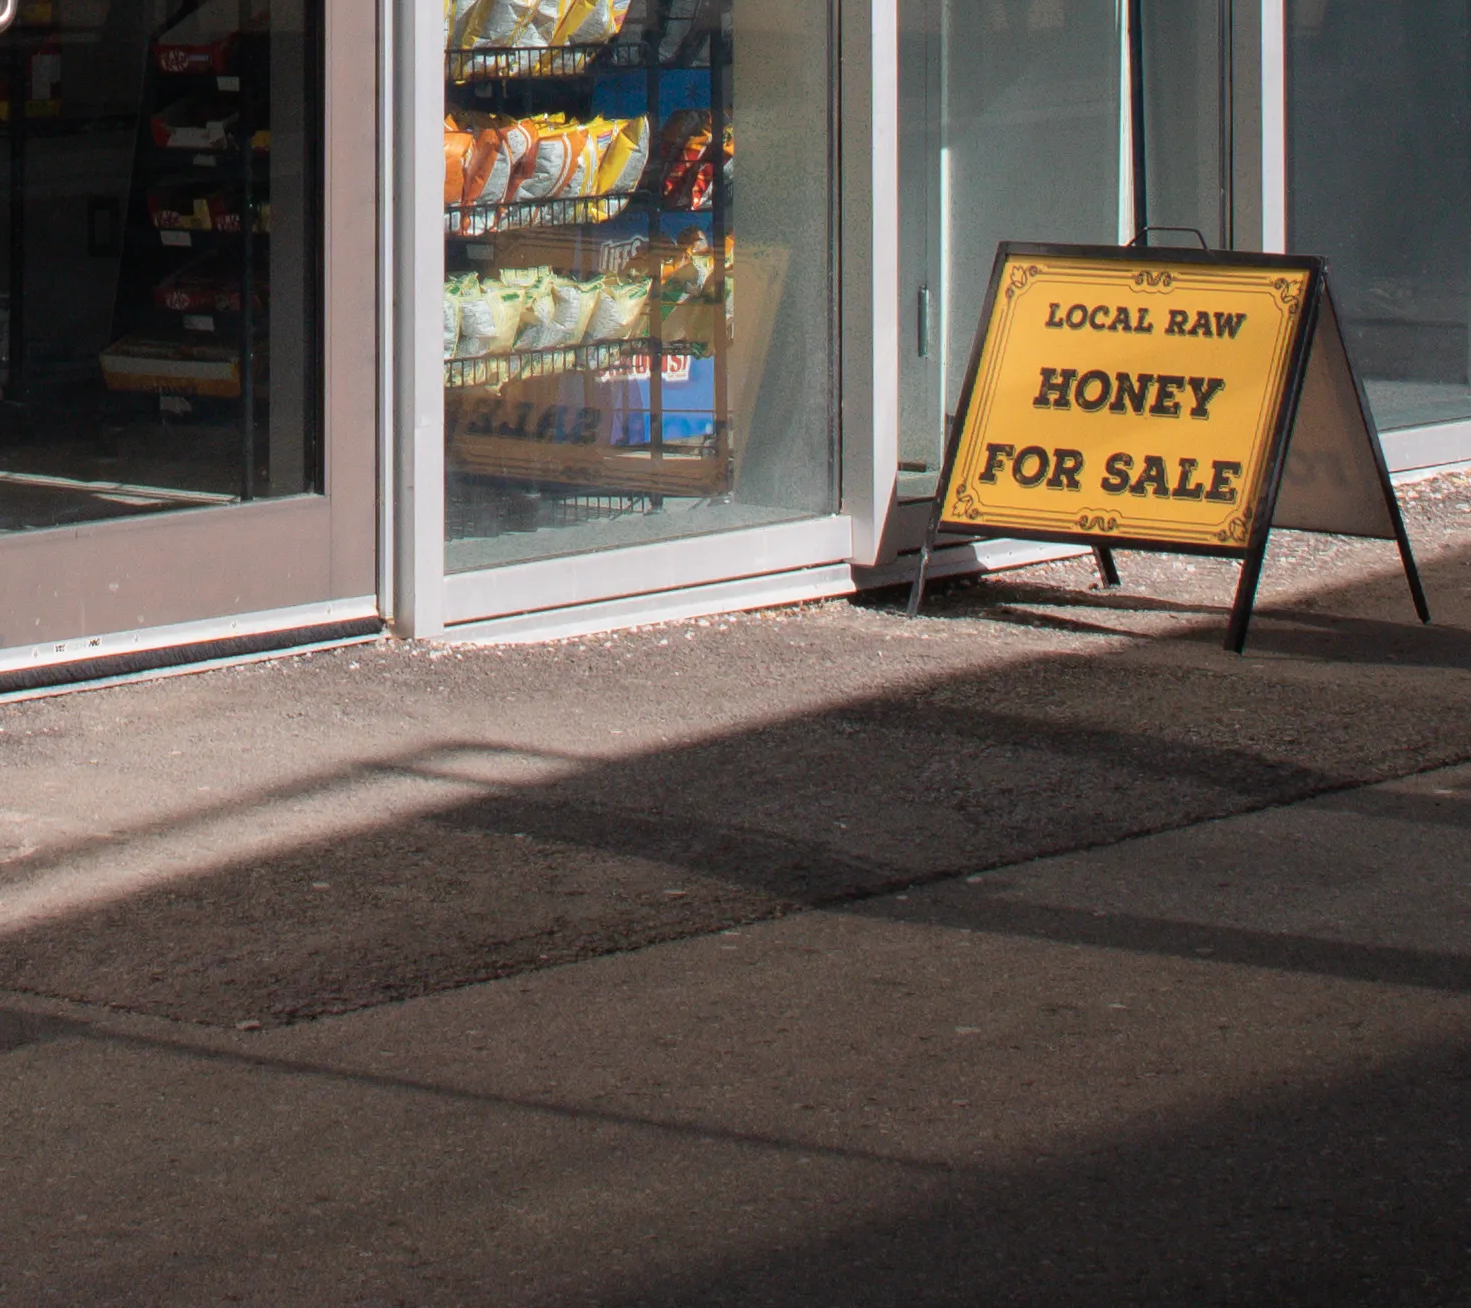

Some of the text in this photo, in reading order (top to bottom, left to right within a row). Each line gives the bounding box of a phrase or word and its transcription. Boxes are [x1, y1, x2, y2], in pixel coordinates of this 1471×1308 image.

[1045, 302, 1247, 339] LOCAL RAW
[1032, 367, 1227, 420] HONEY
[978, 442, 1243, 505] FOR SALE
